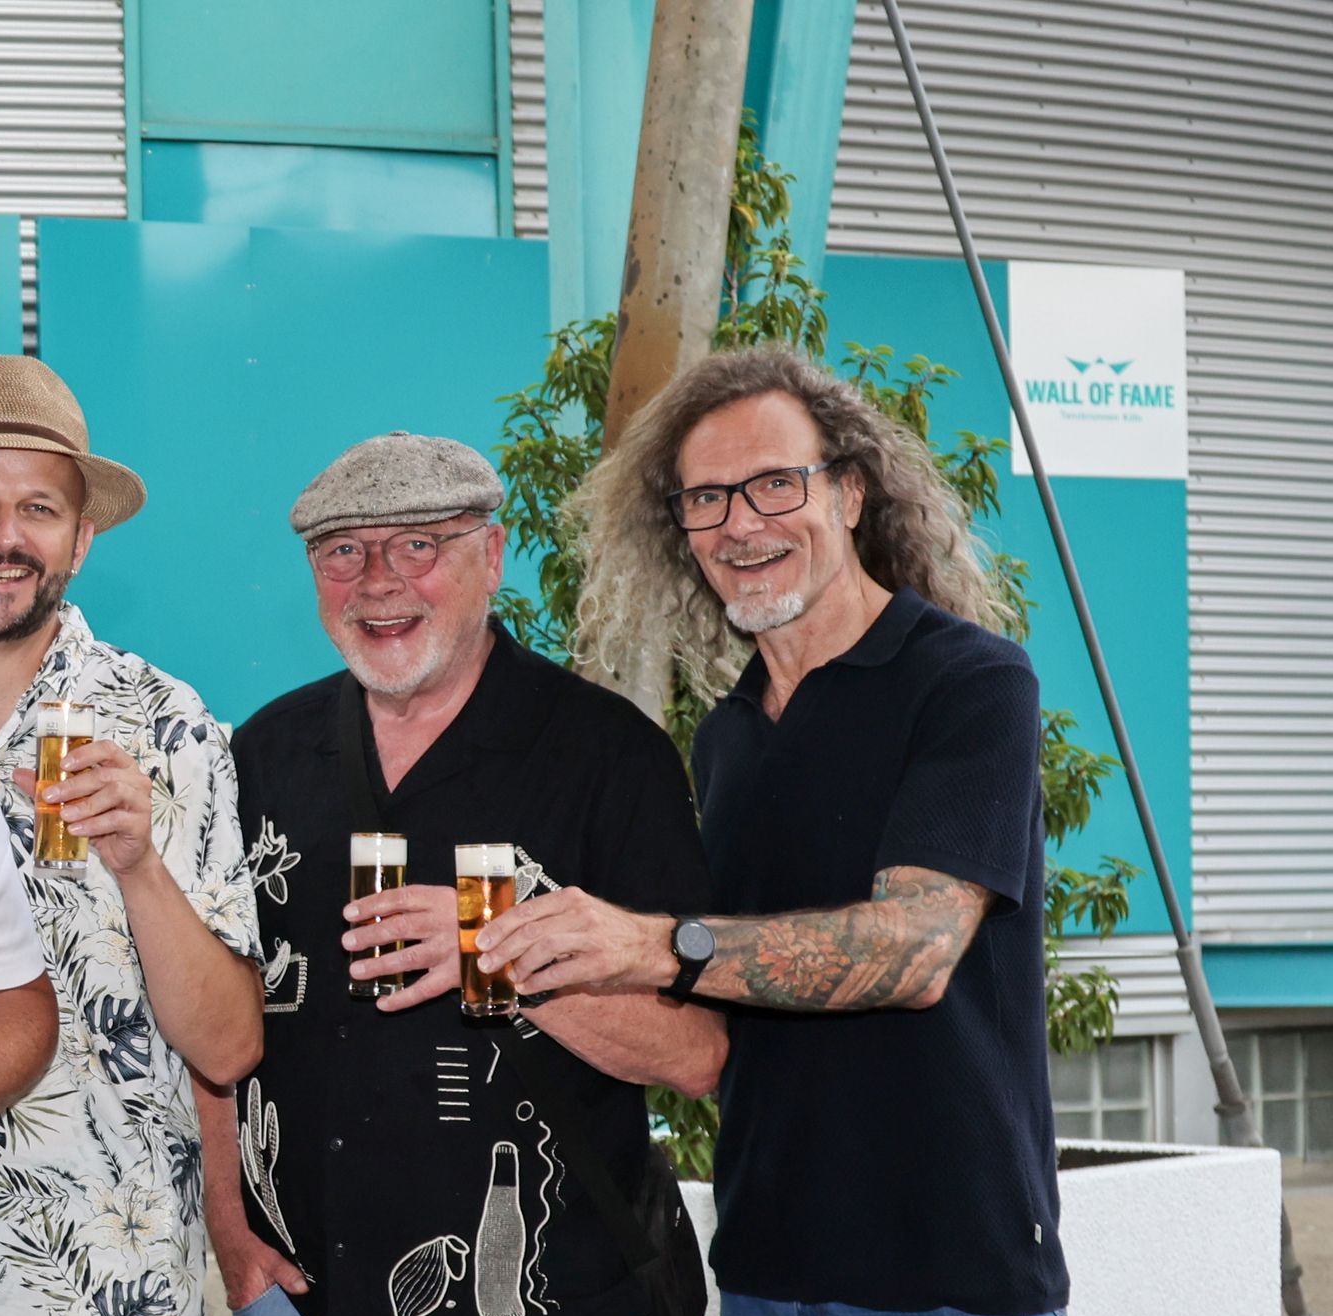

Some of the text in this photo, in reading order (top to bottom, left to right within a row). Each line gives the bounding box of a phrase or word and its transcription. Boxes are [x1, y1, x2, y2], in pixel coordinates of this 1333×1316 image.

[1025, 379, 1175, 409] WALL OF FAME
